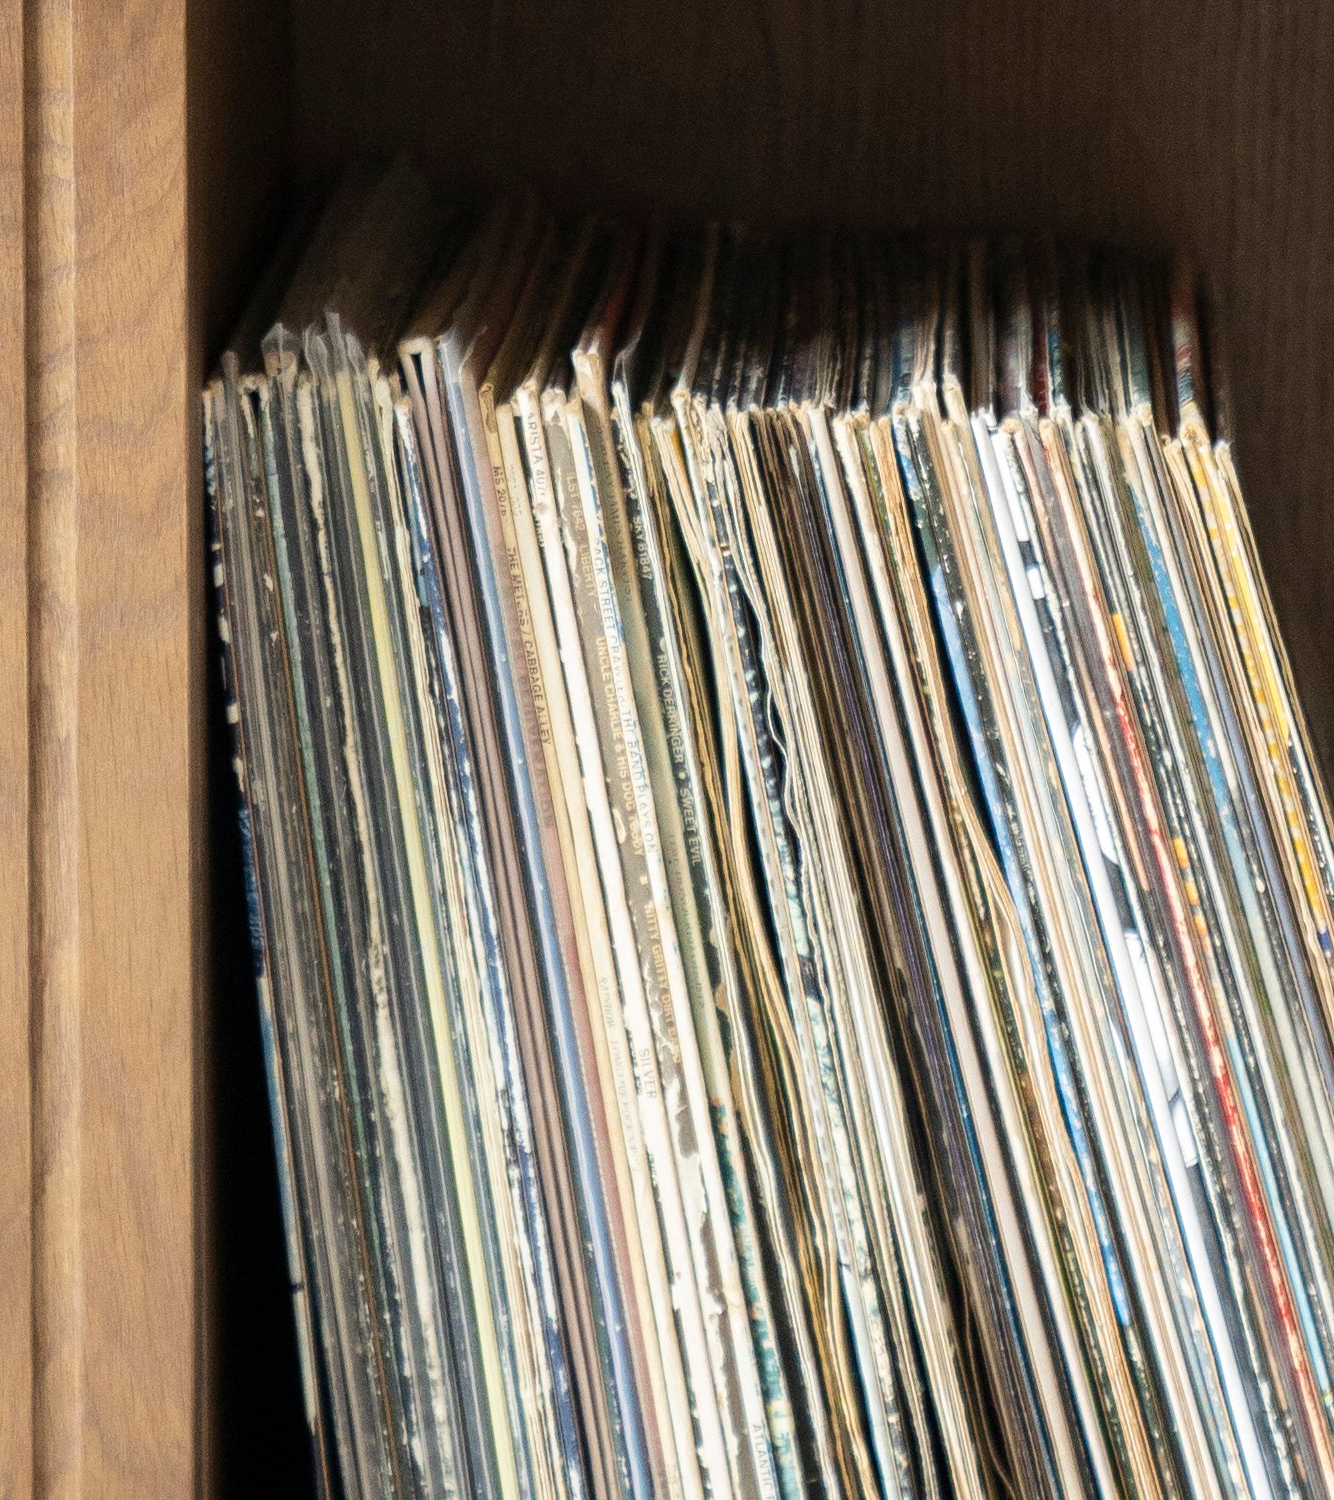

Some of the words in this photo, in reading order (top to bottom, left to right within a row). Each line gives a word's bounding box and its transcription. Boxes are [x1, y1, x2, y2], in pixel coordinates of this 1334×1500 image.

[523, 411, 544, 465] ARISTA
[578, 544, 597, 597] LIBERTY
[506, 546, 519, 570] THE
[522, 639, 543, 702] CABBAGE
[534, 704, 551, 746] ALLEY
[594, 635, 612, 682] UNCLE
[654, 654, 670, 685] RICK
[596, 579, 616, 630] STREET
[625, 739, 643, 781] BAND
[642, 831, 657, 854] ON
[602, 683, 623, 741] CHARLIE
[660, 687, 684, 763] DERRINGER
[616, 755, 630, 779] HIS
[621, 780, 636, 811] DOG
[678, 787, 697, 834] SWEET
[687, 836, 702, 866] EVIL
[643, 903, 660, 941] NITTY
[650, 943, 669, 991] GRITTY
[660, 993, 675, 1024] DIRT
[636, 1046, 659, 1101] SILVER
[750, 1422, 774, 1492] ATLANTIC
